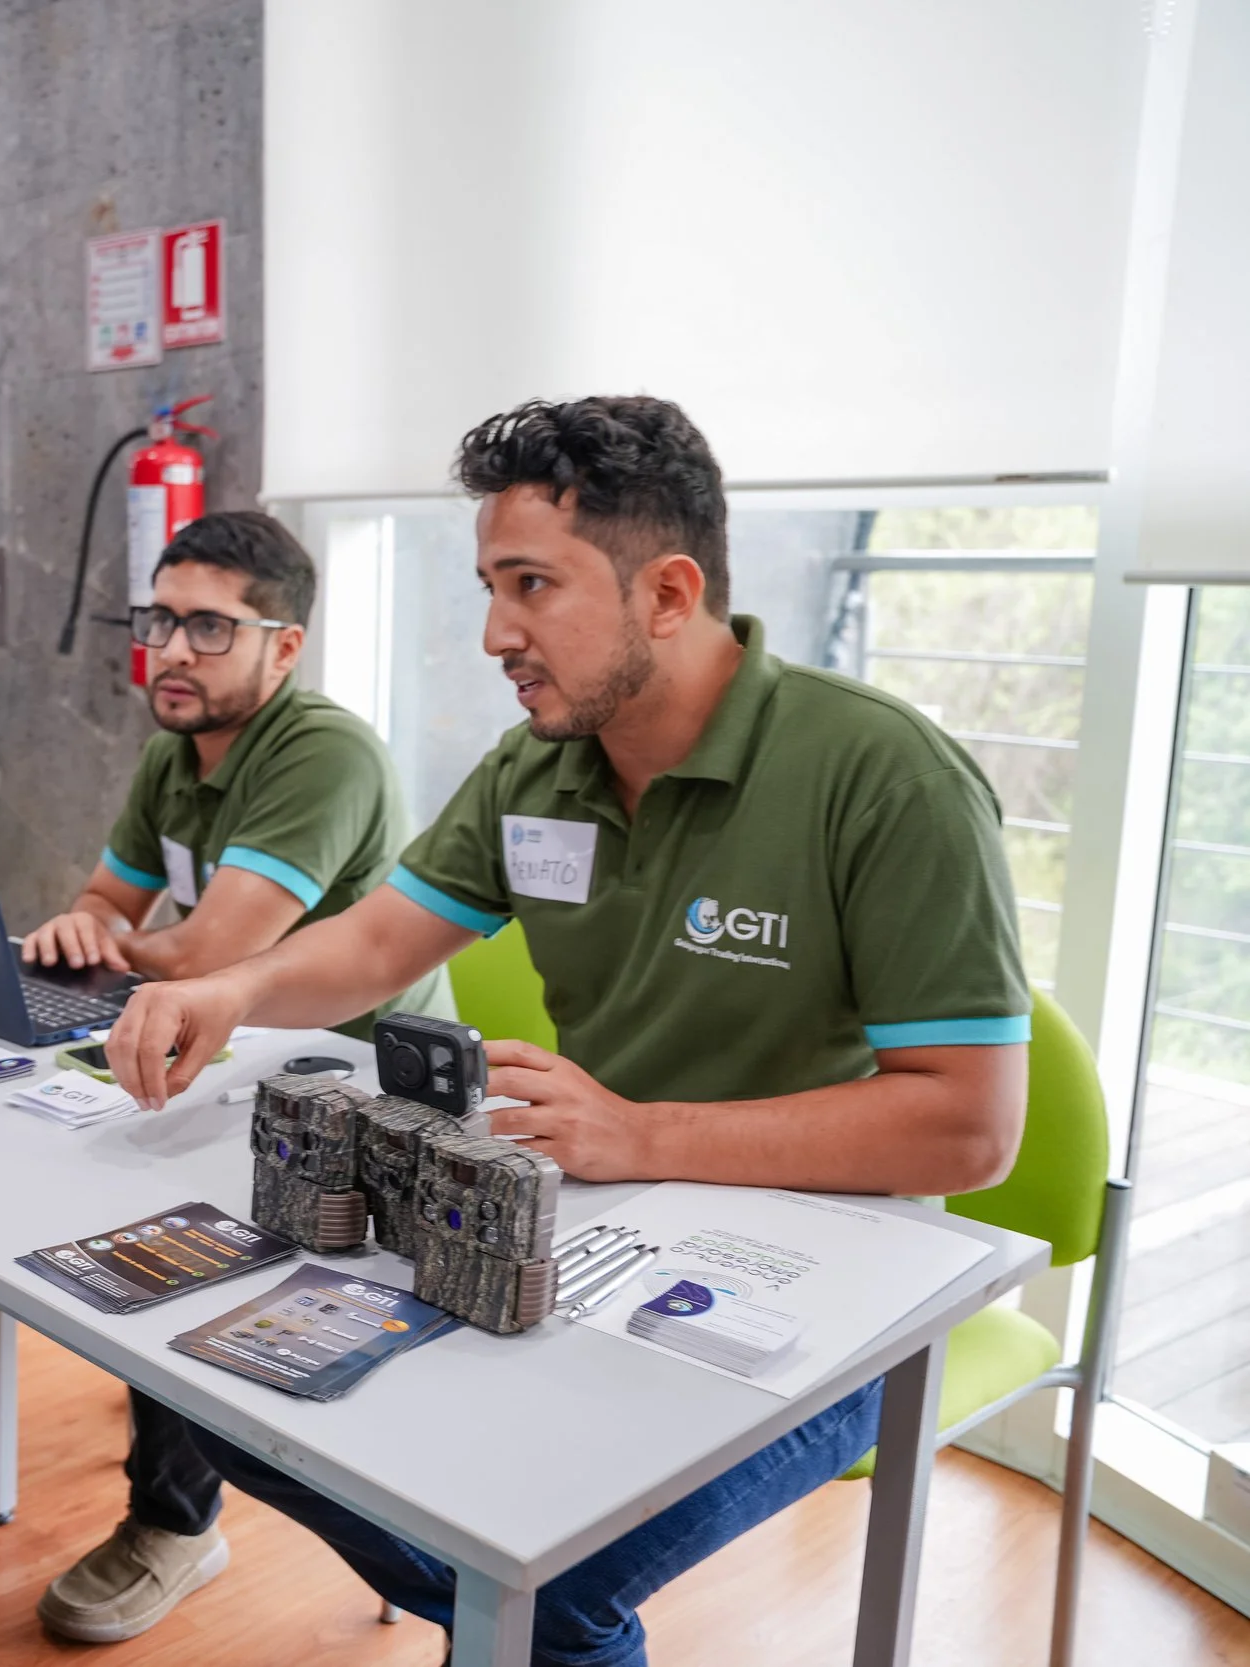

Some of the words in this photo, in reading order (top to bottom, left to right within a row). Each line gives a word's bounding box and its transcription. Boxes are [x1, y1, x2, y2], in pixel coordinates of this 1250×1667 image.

[725, 908, 789, 948] GTI
[62, 1090, 99, 1105] GTI
[231, 1229, 263, 1243] GTI
[69, 1257, 96, 1270] GTI
[669, 1246, 792, 1285] encuentro
[676, 1240, 801, 1279] empresarial
[364, 1292, 400, 1307] GTI
